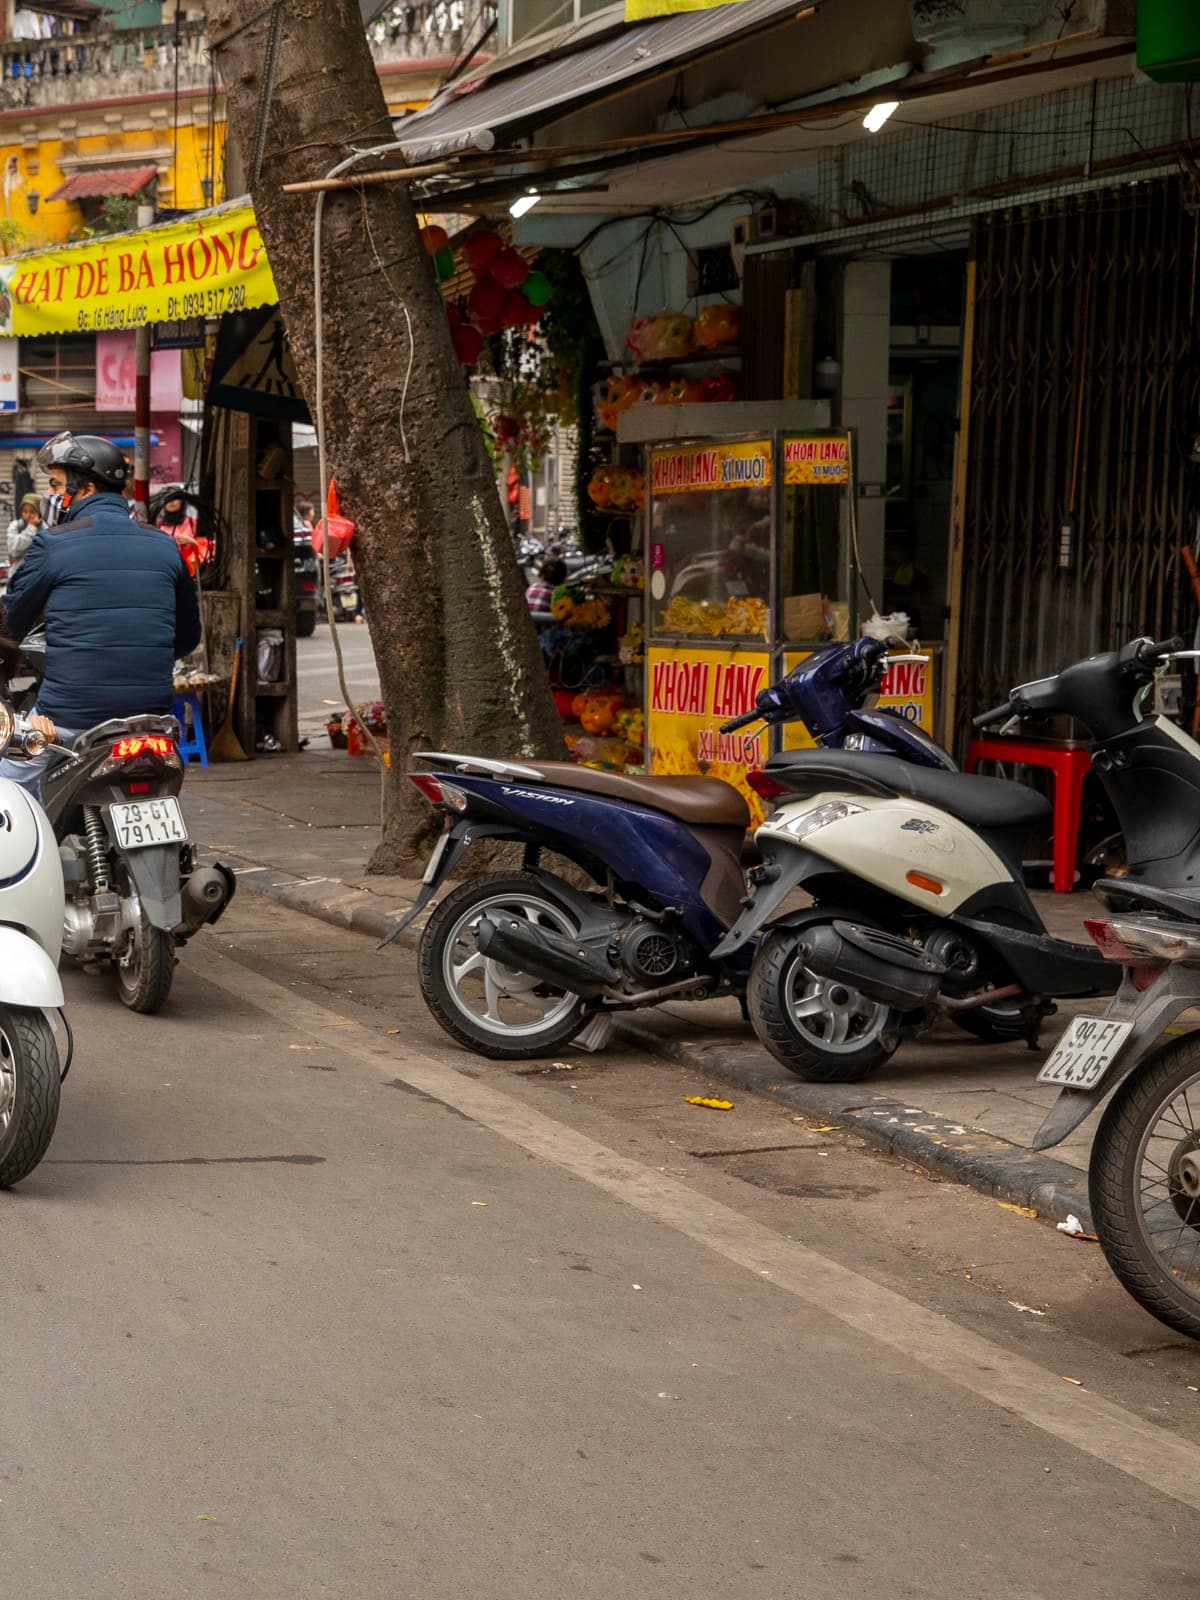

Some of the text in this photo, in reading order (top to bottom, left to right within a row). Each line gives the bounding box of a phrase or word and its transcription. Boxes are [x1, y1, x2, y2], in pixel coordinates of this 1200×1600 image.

[15, 266, 70, 311] HẠT
[119, 240, 155, 292] BÀ
[183, 293, 205, 316] 0934
[207, 289, 225, 312] 517
[228, 285, 246, 309] 280
[785, 442, 846, 460] KHOAI LANG
[689, 451, 718, 483] LANG
[652, 660, 710, 715] KHOAI
[880, 662, 928, 697] ANG
[500, 785, 576, 806] VISION
[120, 801, 171, 826] 29-G1
[120, 819, 182, 847] 791.14
[1043, 1051, 1108, 1083] 224.95
